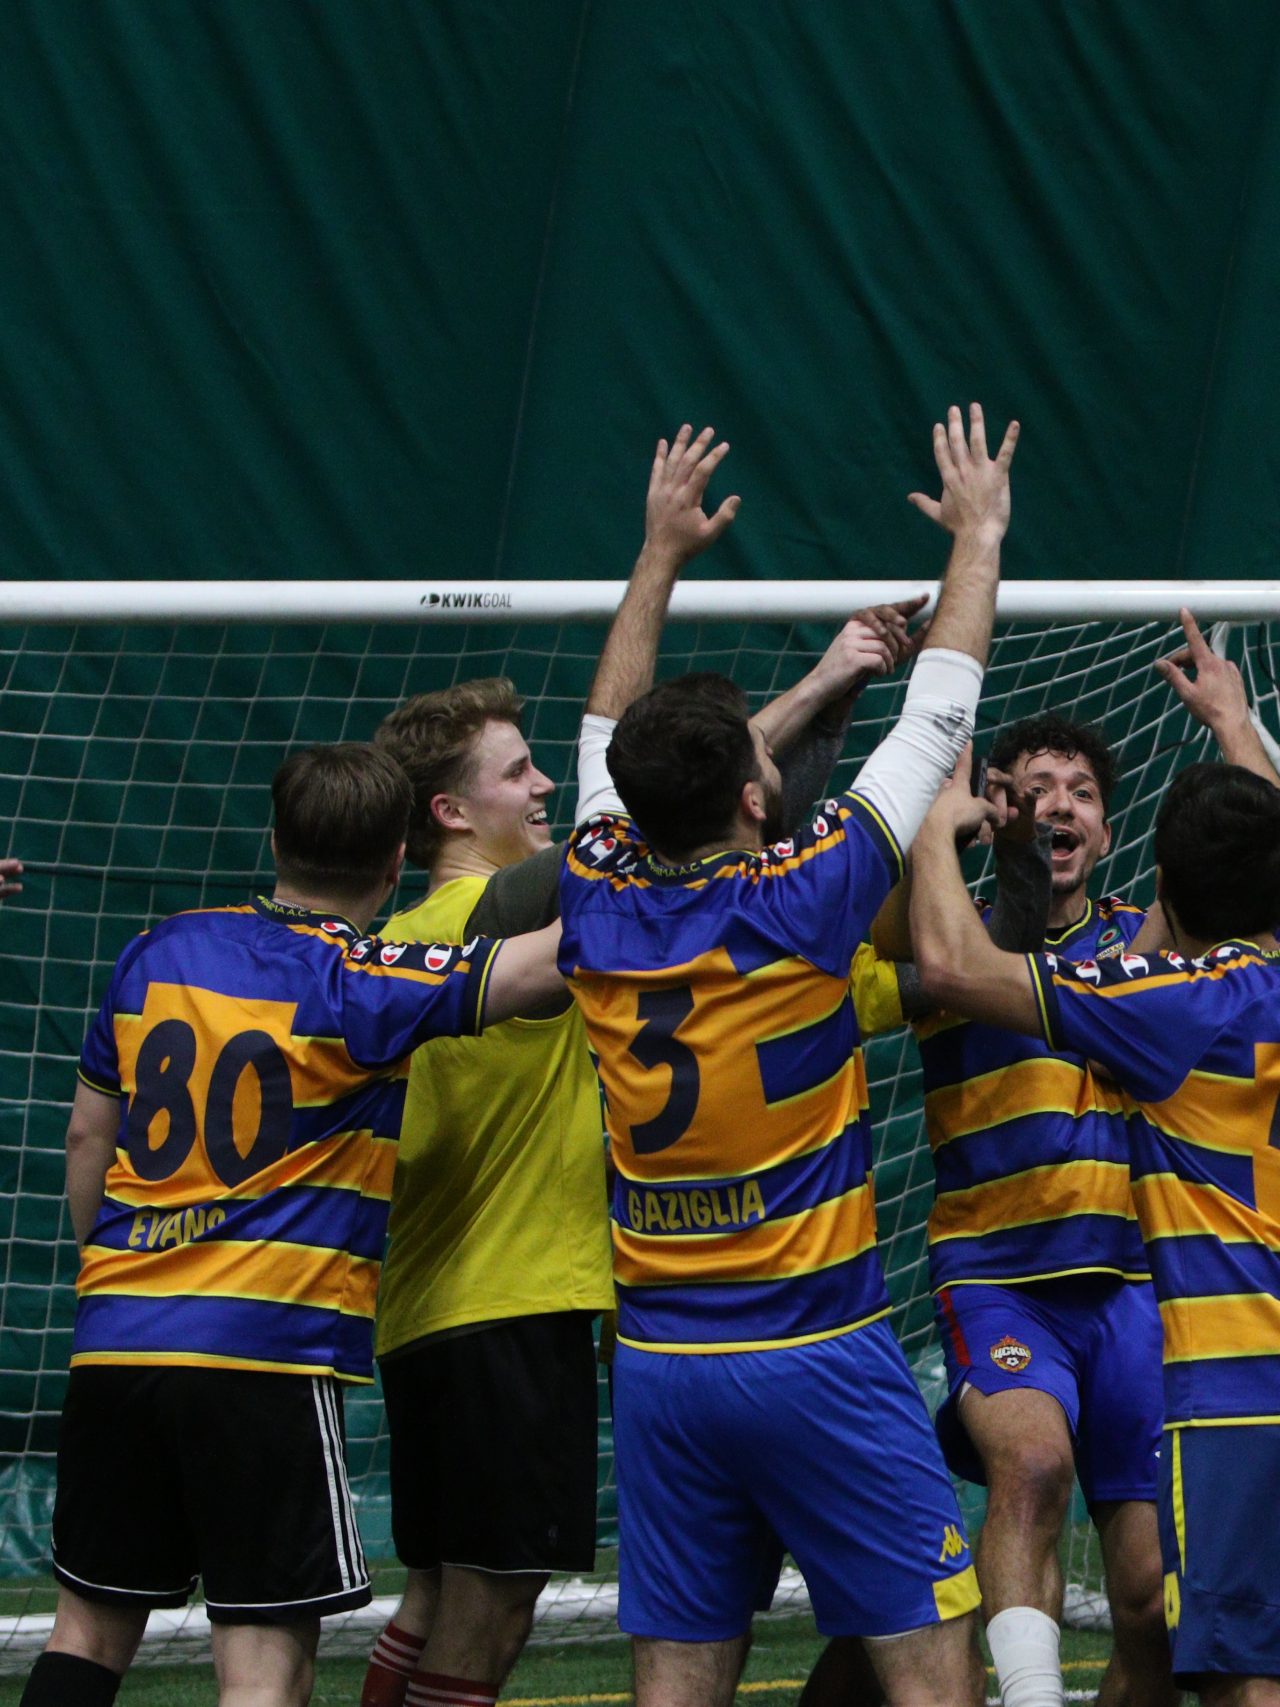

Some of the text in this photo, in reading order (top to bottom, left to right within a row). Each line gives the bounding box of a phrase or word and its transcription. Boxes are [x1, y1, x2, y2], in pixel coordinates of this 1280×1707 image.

[128, 1019, 294, 1189] 80
[628, 985, 700, 1154] 3
[628, 1179, 765, 1231] GAZIGLIA
